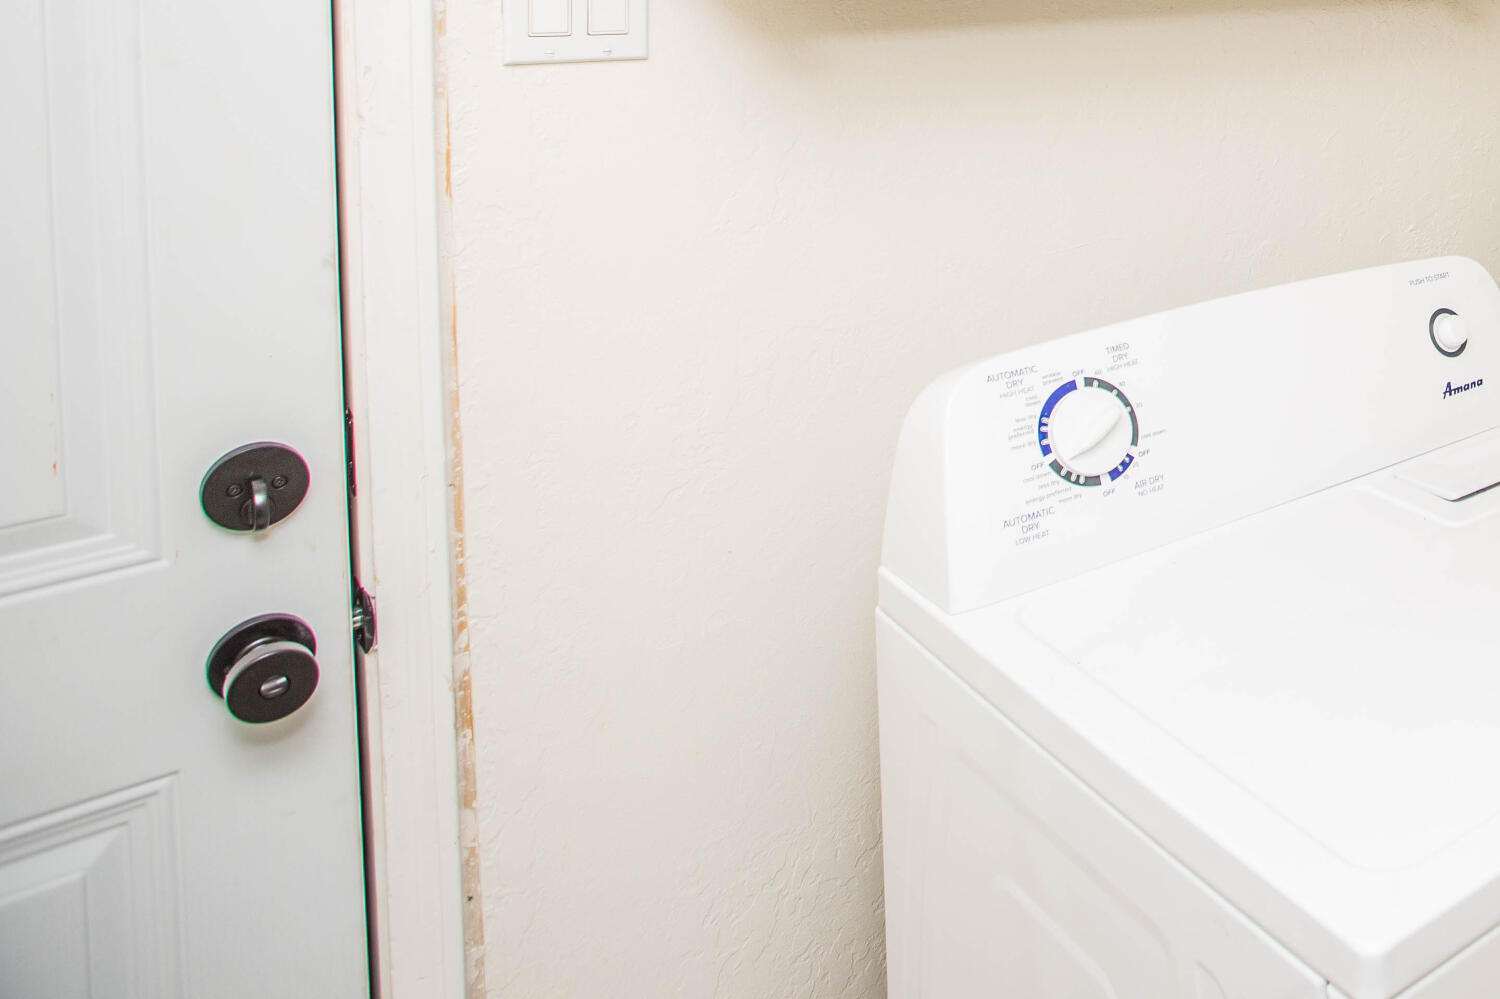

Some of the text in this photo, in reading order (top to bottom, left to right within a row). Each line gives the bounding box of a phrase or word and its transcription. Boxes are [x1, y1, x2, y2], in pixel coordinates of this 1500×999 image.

[1105, 342, 1130, 354] TIMED
[1112, 352, 1128, 363] DRY
[986, 365, 1038, 383] AUTOMATIC
[1005, 378, 1024, 389] DRY
[1443, 379, 1483, 399] Amana
[1031, 462, 1044, 471] OFF
[1134, 473, 1164, 489] AIR DRY
[1102, 488, 1115, 497] OFF
[1003, 506, 1055, 528] AUTOMATIC
[1021, 521, 1040, 534] DRY
[1015, 530, 1049, 546] LOW HEAT
